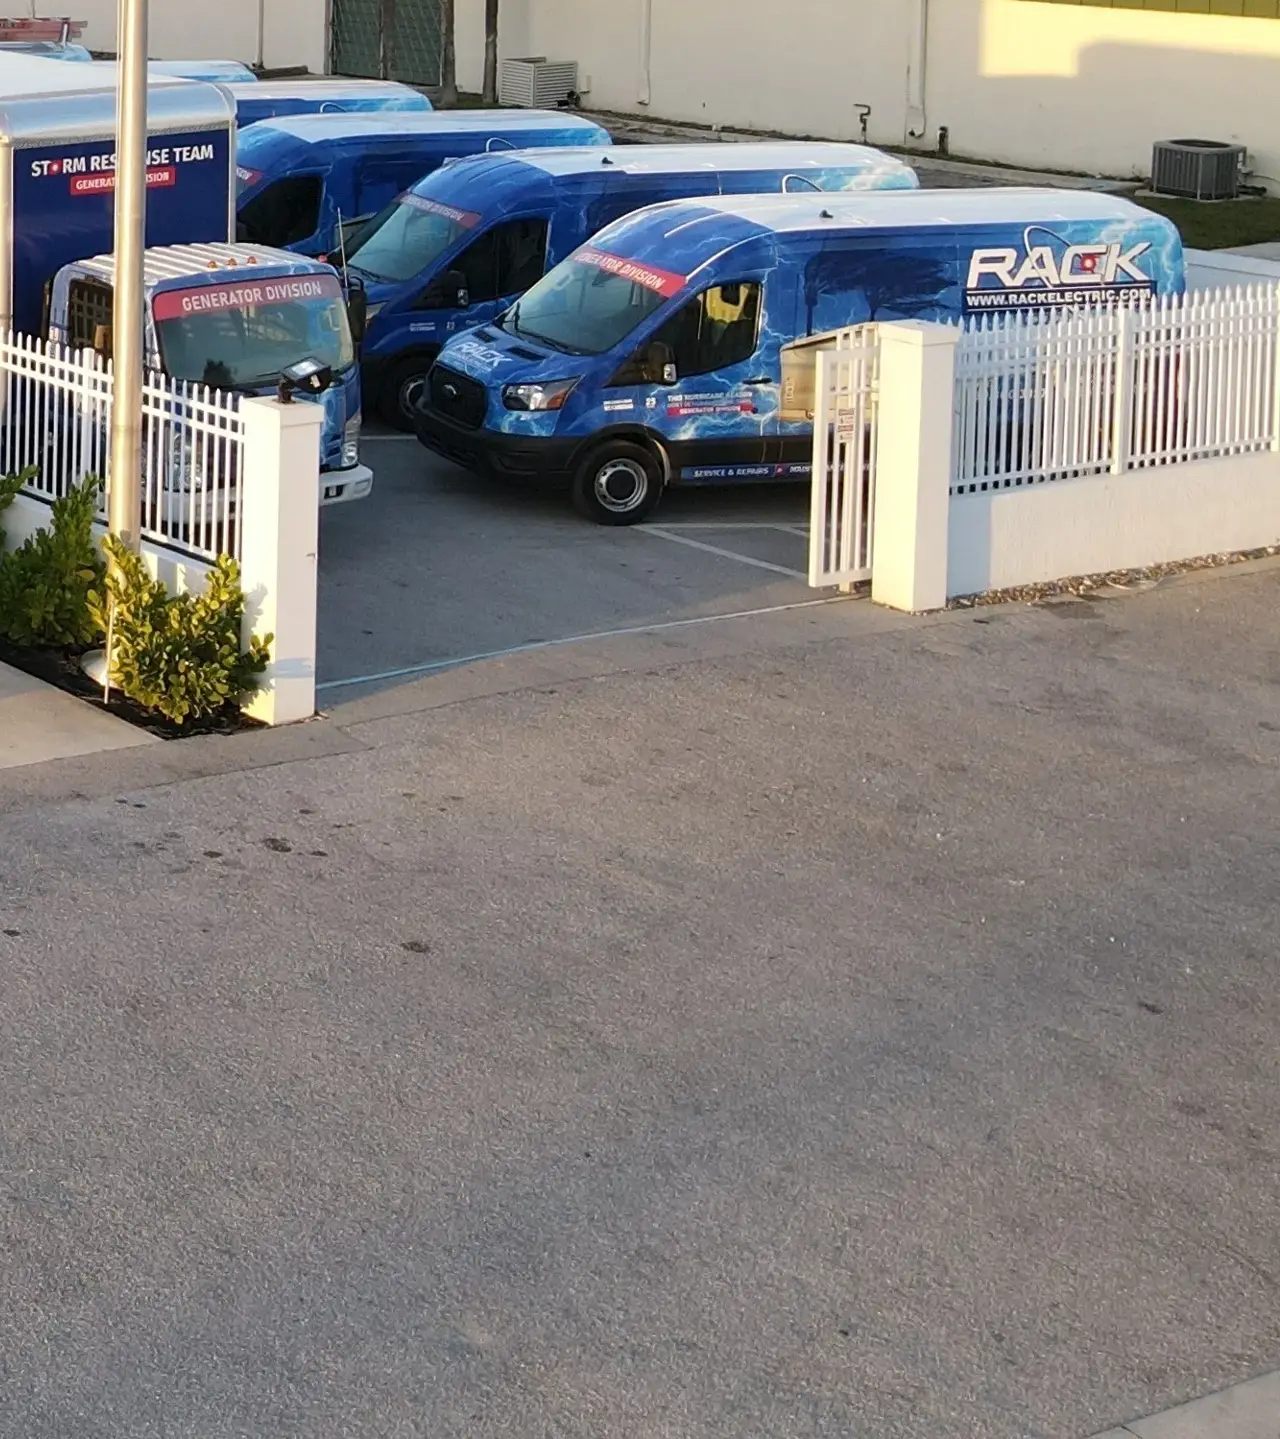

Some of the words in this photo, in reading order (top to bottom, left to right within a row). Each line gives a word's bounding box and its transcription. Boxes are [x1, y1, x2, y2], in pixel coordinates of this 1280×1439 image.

[173, 144, 214, 163] TEAM
[621, 263, 666, 289] DIVISION
[967, 242, 1152, 289] RACK
[182, 287, 262, 312] GENERATOR
[265, 281, 322, 301] DIVISION
[967, 288, 1151, 307] WWW.RACKELECTRIC.COM
